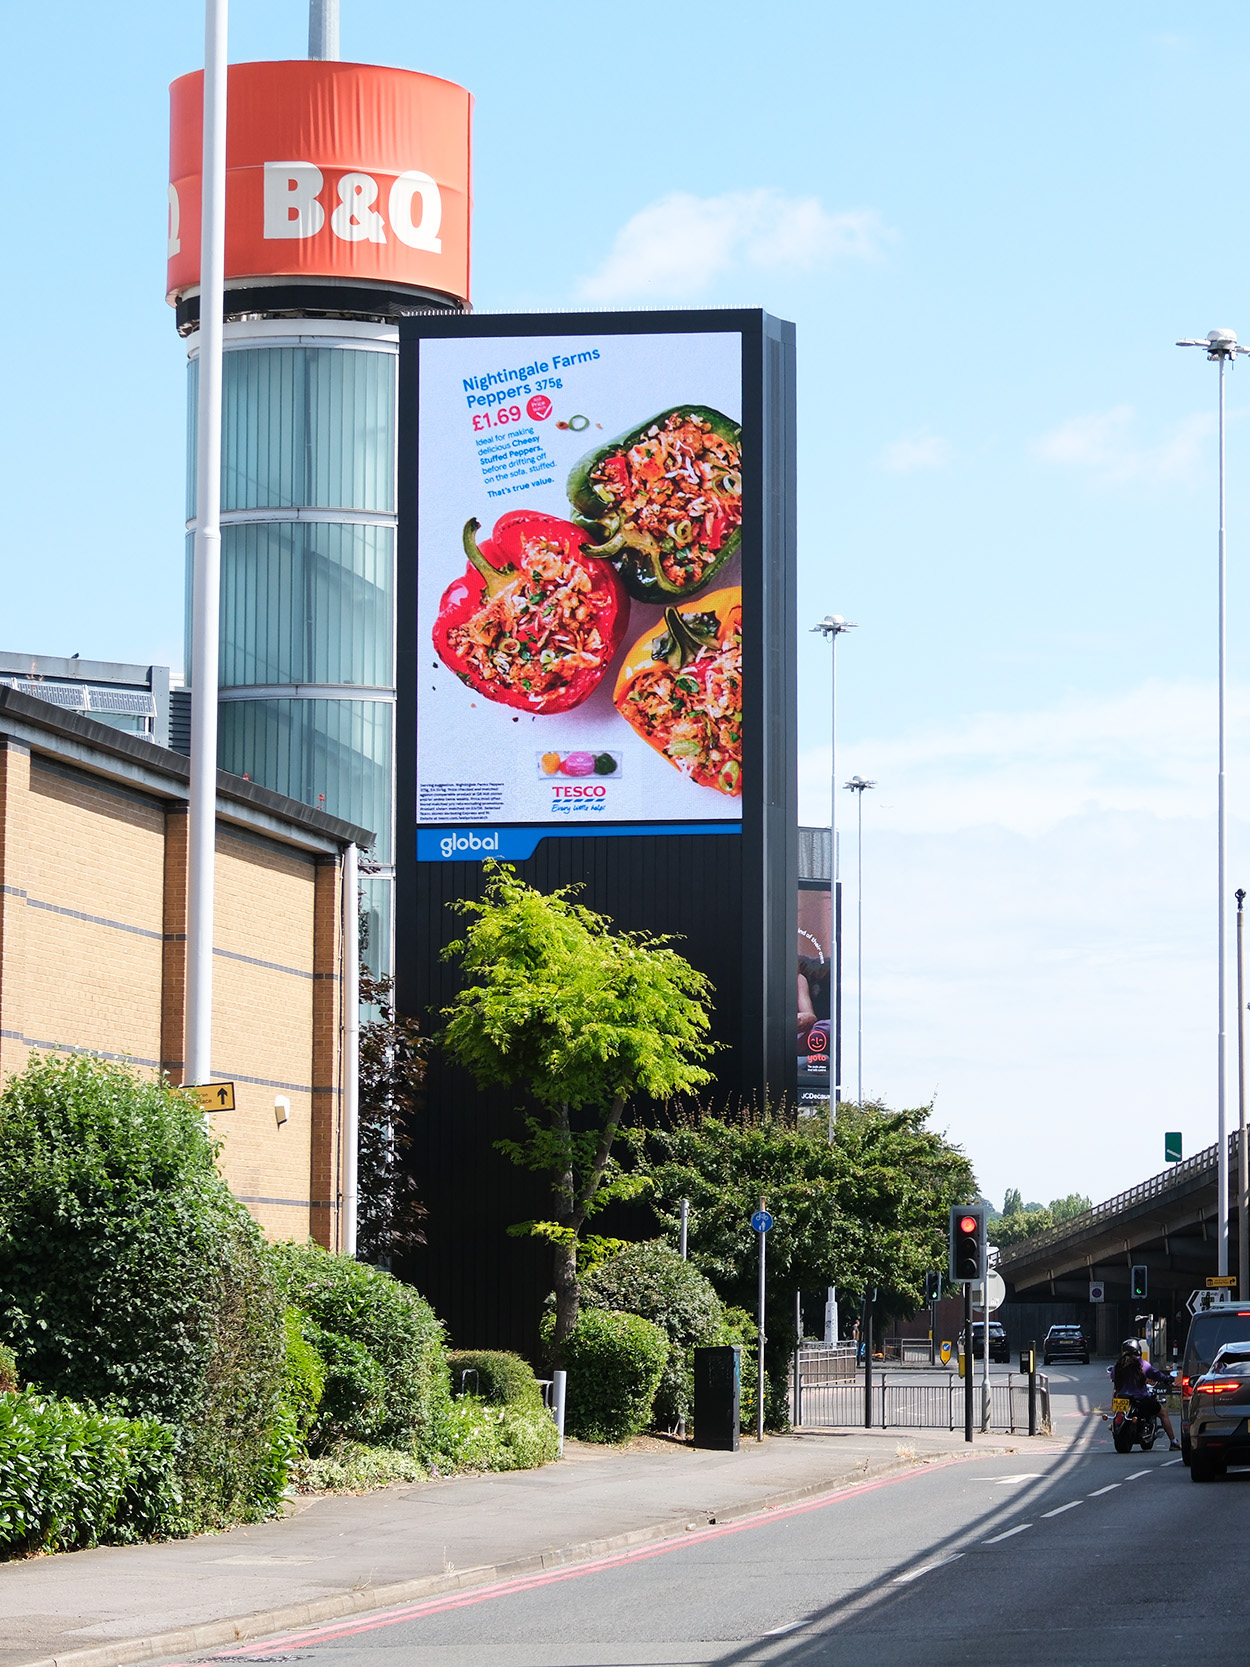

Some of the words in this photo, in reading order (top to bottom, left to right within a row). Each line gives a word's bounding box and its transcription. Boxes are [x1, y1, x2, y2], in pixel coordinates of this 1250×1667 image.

[264, 161, 442, 254] B&Q
[462, 362, 549, 392] Nightingale
[552, 349, 600, 370] Farms
[466, 384, 532, 408] Peppers
[535, 378, 563, 391] 375g
[472, 406, 521, 431] £1.69
[476, 437, 494, 446] Ideal
[508, 428, 534, 438] making
[478, 443, 511, 456] delicious
[512, 436, 540, 447] Cheesy
[480, 452, 507, 465] Stuffed
[482, 464, 507, 475] before
[509, 457, 536, 468] drifting
[536, 452, 546, 460] off
[529, 461, 557, 473] stuffed.
[487, 488, 511, 498] That's
[512, 483, 529, 491] true
[531, 478, 554, 487] value.
[552, 786, 606, 797] TESCO
[552, 804, 571, 814] Every
[440, 832, 499, 857] global
[807, 1054, 826, 1063] yoto
